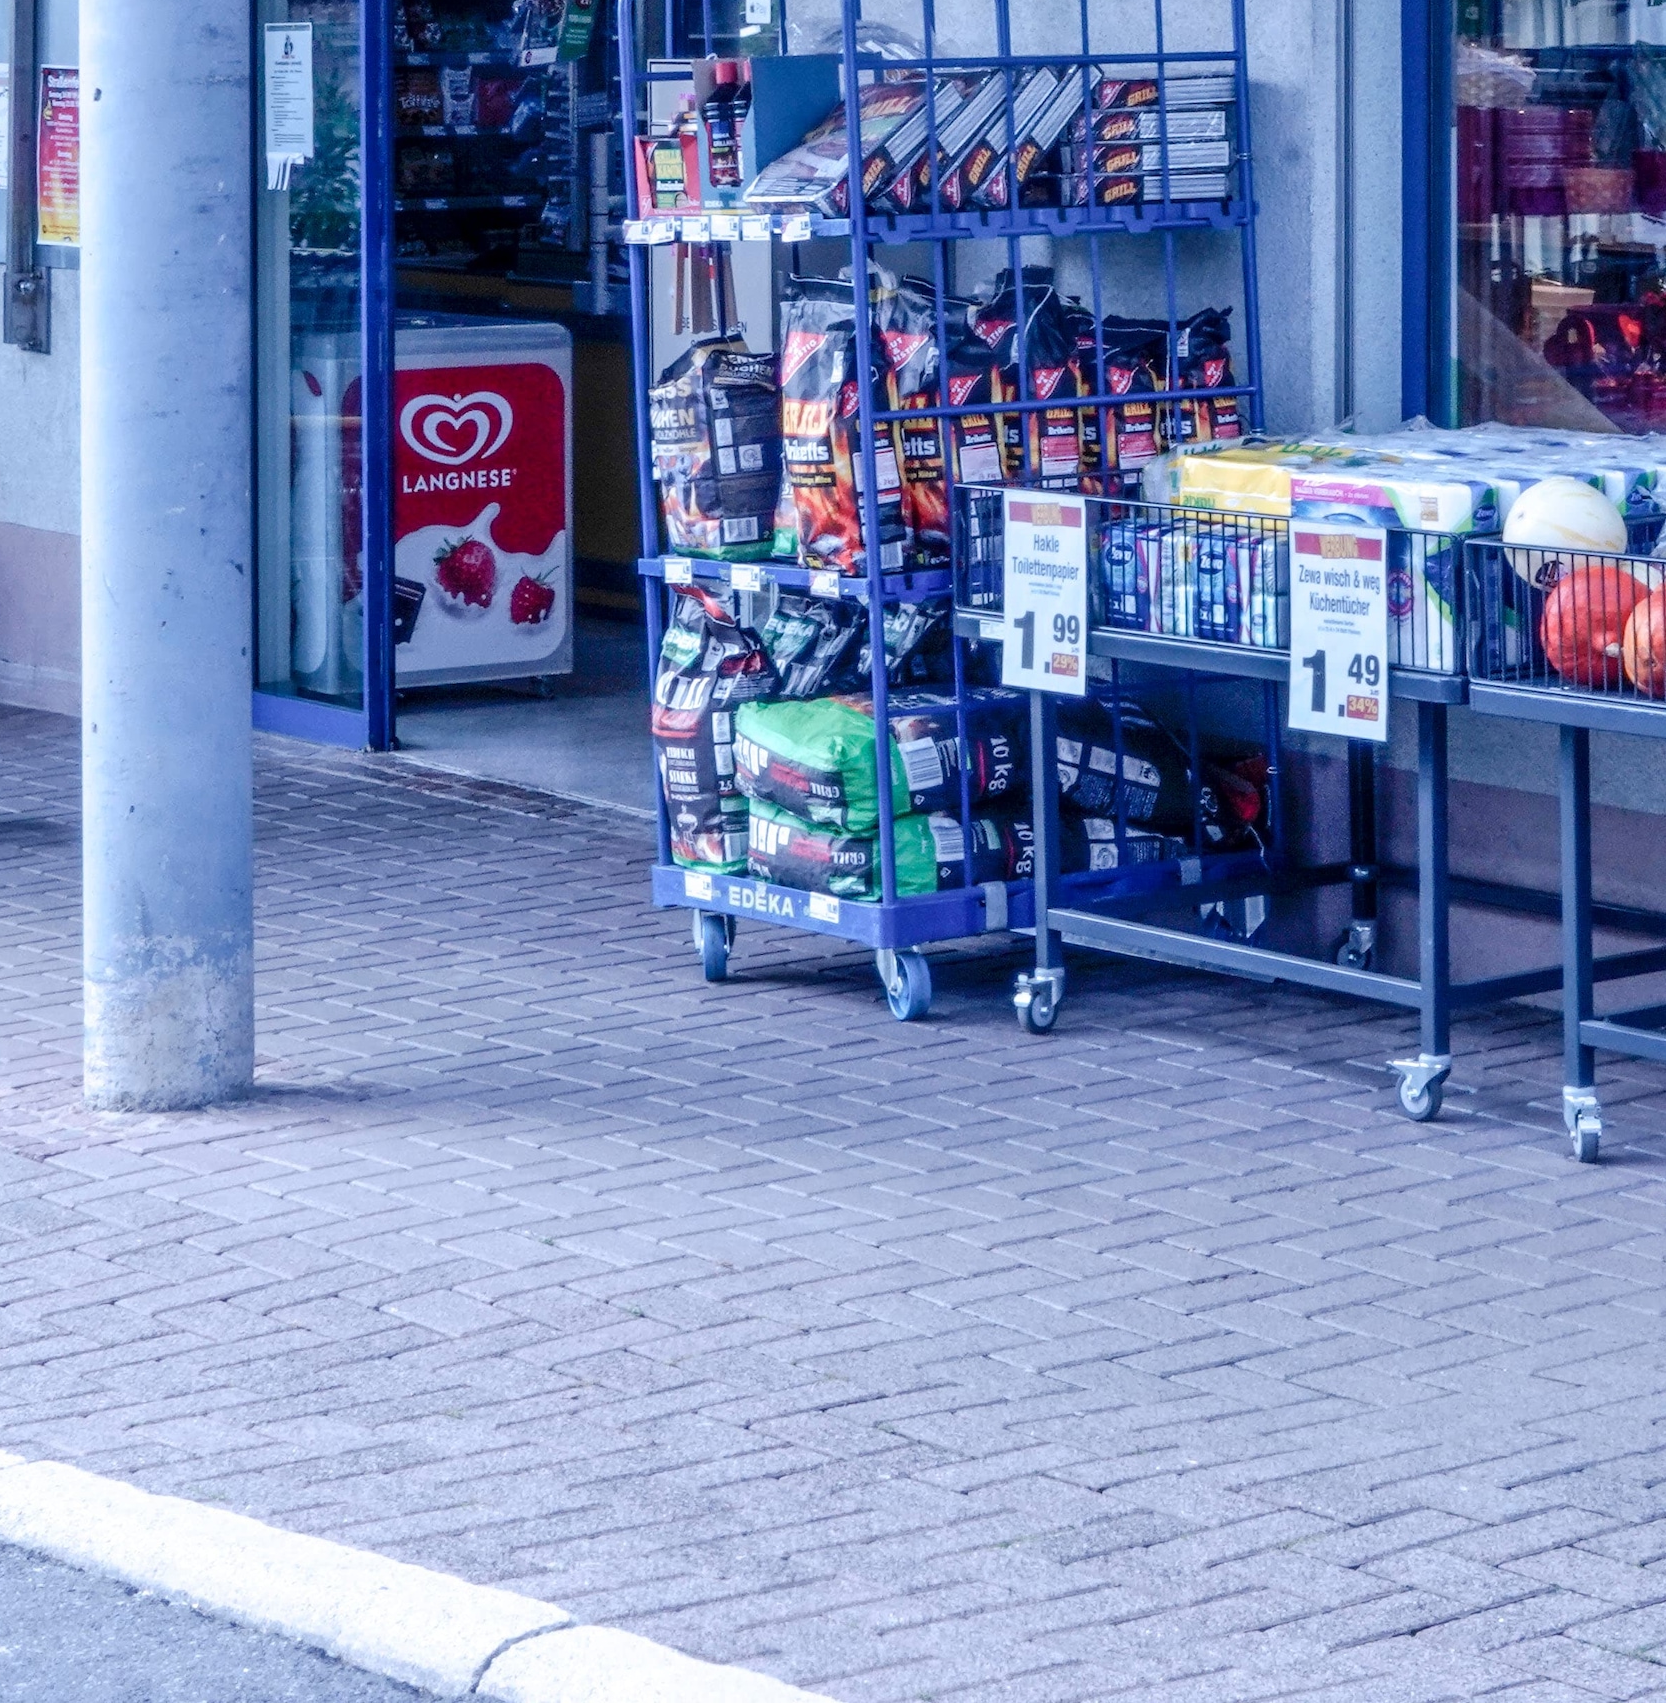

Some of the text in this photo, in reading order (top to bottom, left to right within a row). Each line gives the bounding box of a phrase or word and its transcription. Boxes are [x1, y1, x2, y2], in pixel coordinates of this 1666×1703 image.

[1103, 181, 1137, 203] GRILL
[402, 468, 513, 495] LANGNESE
[1033, 533, 1061, 553] Hakle
[1012, 555, 1080, 583] Toilettenpapier
[1298, 564, 1381, 596] Zewa wisch & weg
[1309, 591, 1371, 617] Küchentücher
[988, 735, 1015, 792] 10 kg
[1013, 821, 1035, 874] 10 kg
[728, 884, 795, 919] EDEKA
